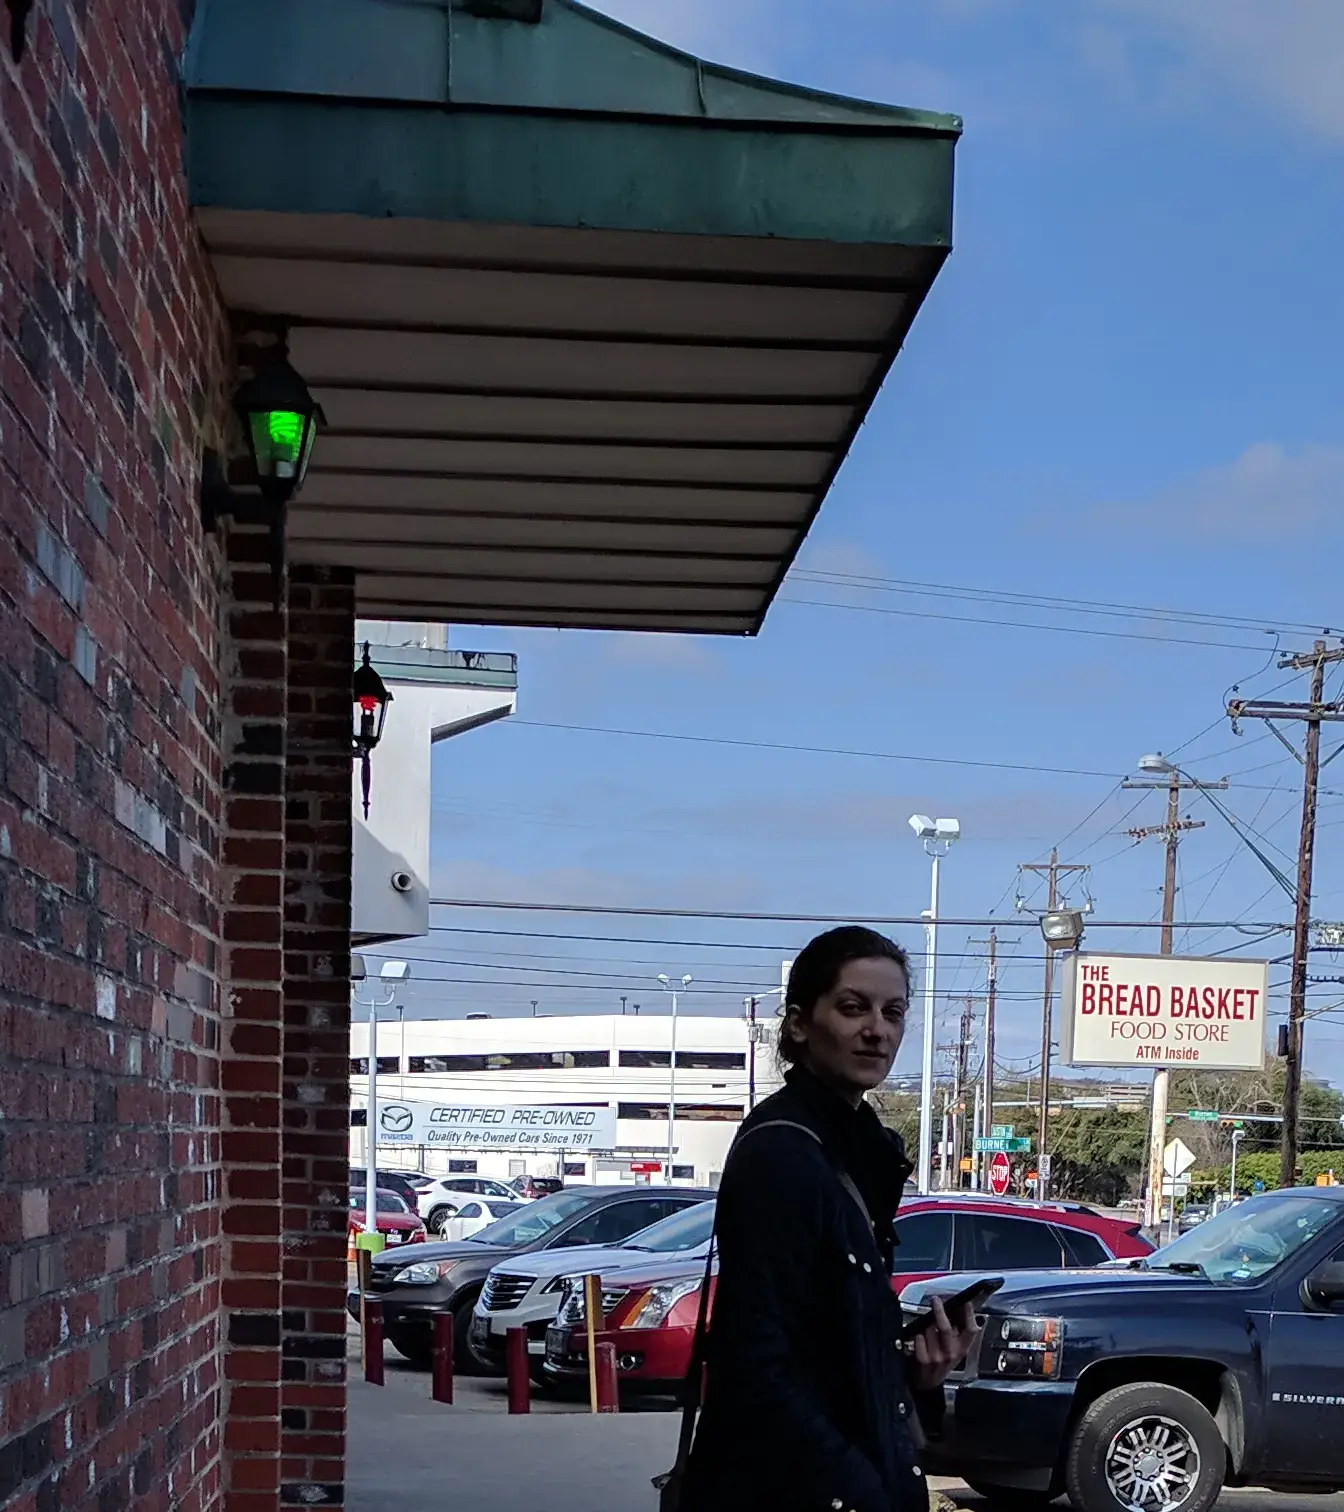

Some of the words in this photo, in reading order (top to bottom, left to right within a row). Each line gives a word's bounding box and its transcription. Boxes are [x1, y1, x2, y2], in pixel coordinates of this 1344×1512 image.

[1081, 965, 1110, 981] THE
[1081, 983, 1161, 1017] BREAD
[1170, 986, 1260, 1021] BASKET
[1110, 1021, 1167, 1040] FOOD
[1173, 1023, 1229, 1042] STORE
[1136, 1045, 1161, 1060] ATM
[1165, 1046, 1200, 1061] Inside
[429, 1107, 505, 1124] CERTIFIED
[511, 1109, 596, 1126] PRE-OWNED
[427, 1130, 461, 1144] Quality
[462, 1132, 515, 1143] Pre-Owned
[518, 1132, 540, 1143] Cars
[542, 1132, 569, 1144] Since
[572, 1133, 593, 1145] 1971
[975, 1138, 1009, 1150] BURNET
[991, 1164, 1008, 1182] STOP
